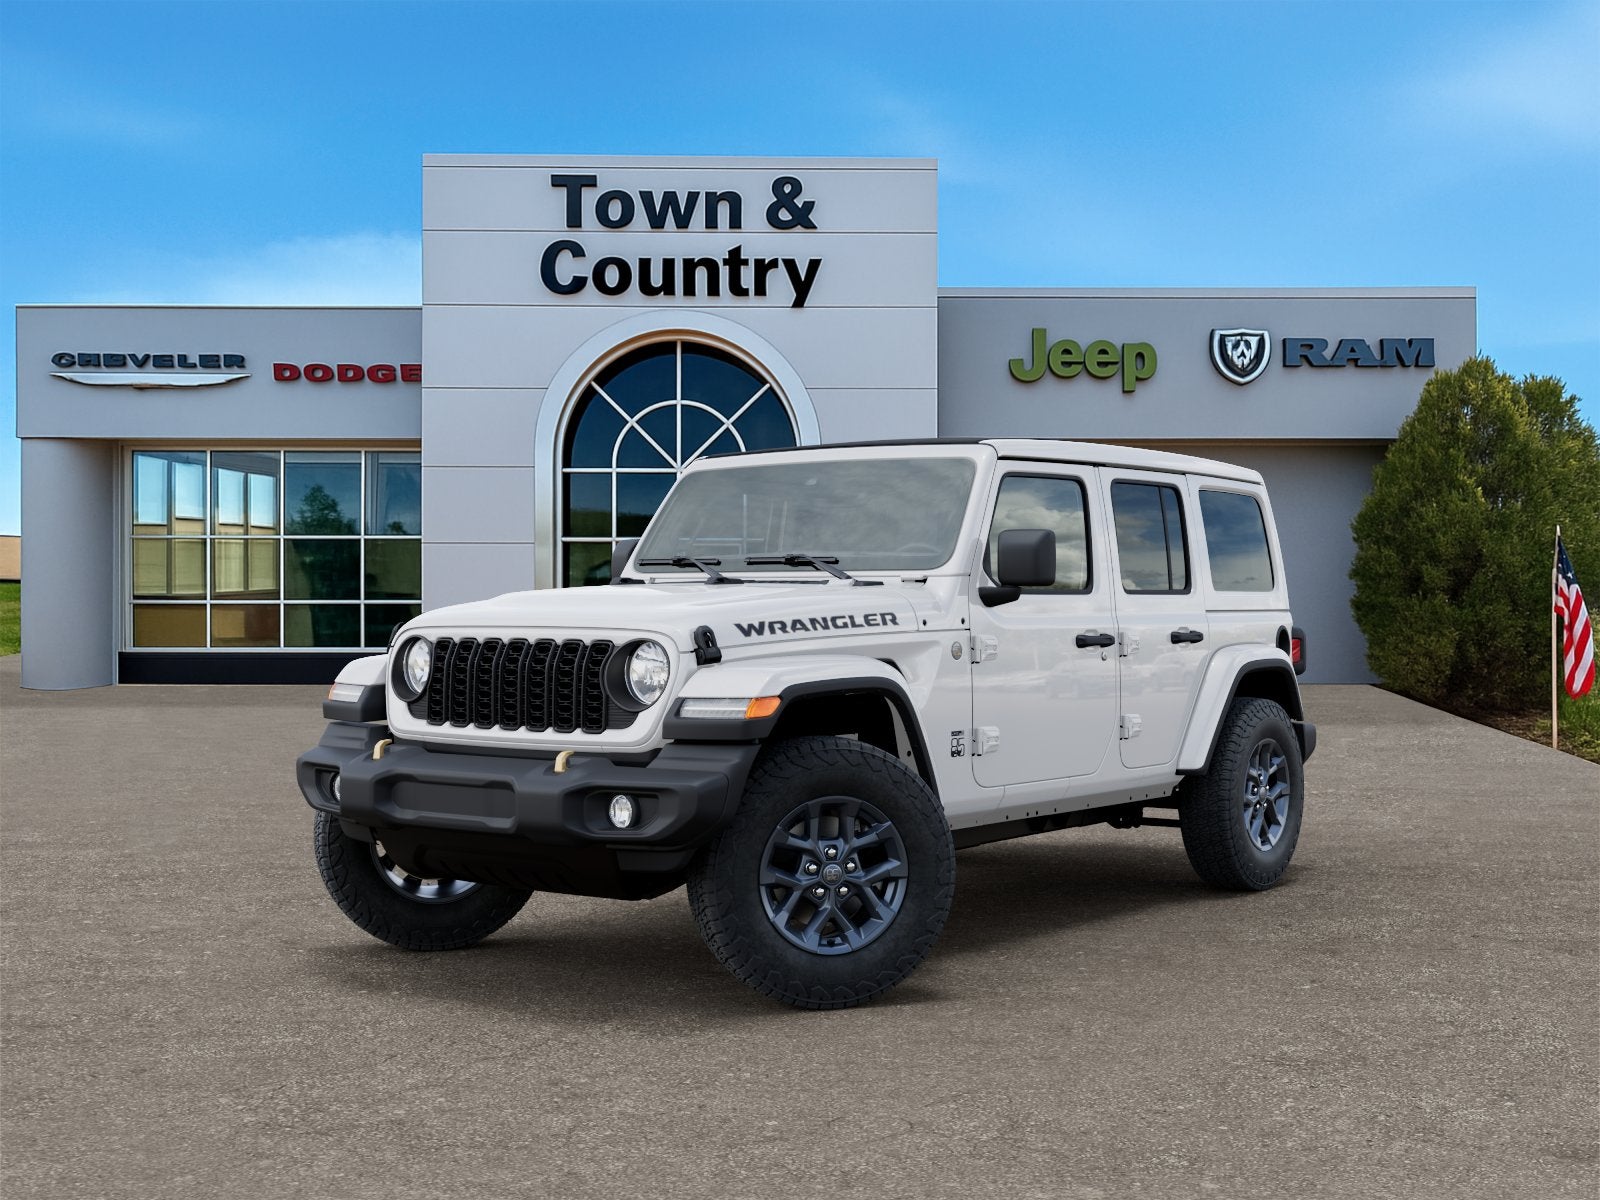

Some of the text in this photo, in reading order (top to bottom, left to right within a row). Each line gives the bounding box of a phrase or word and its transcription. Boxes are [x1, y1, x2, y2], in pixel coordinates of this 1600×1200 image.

[550, 174, 818, 230] Town &
[540, 239, 822, 308] Country
[273, 363, 421, 383] DODGE
[1009, 327, 1157, 392] Jeep
[1282, 337, 1435, 368] RAM
[734, 612, 899, 637] WRANGLER
